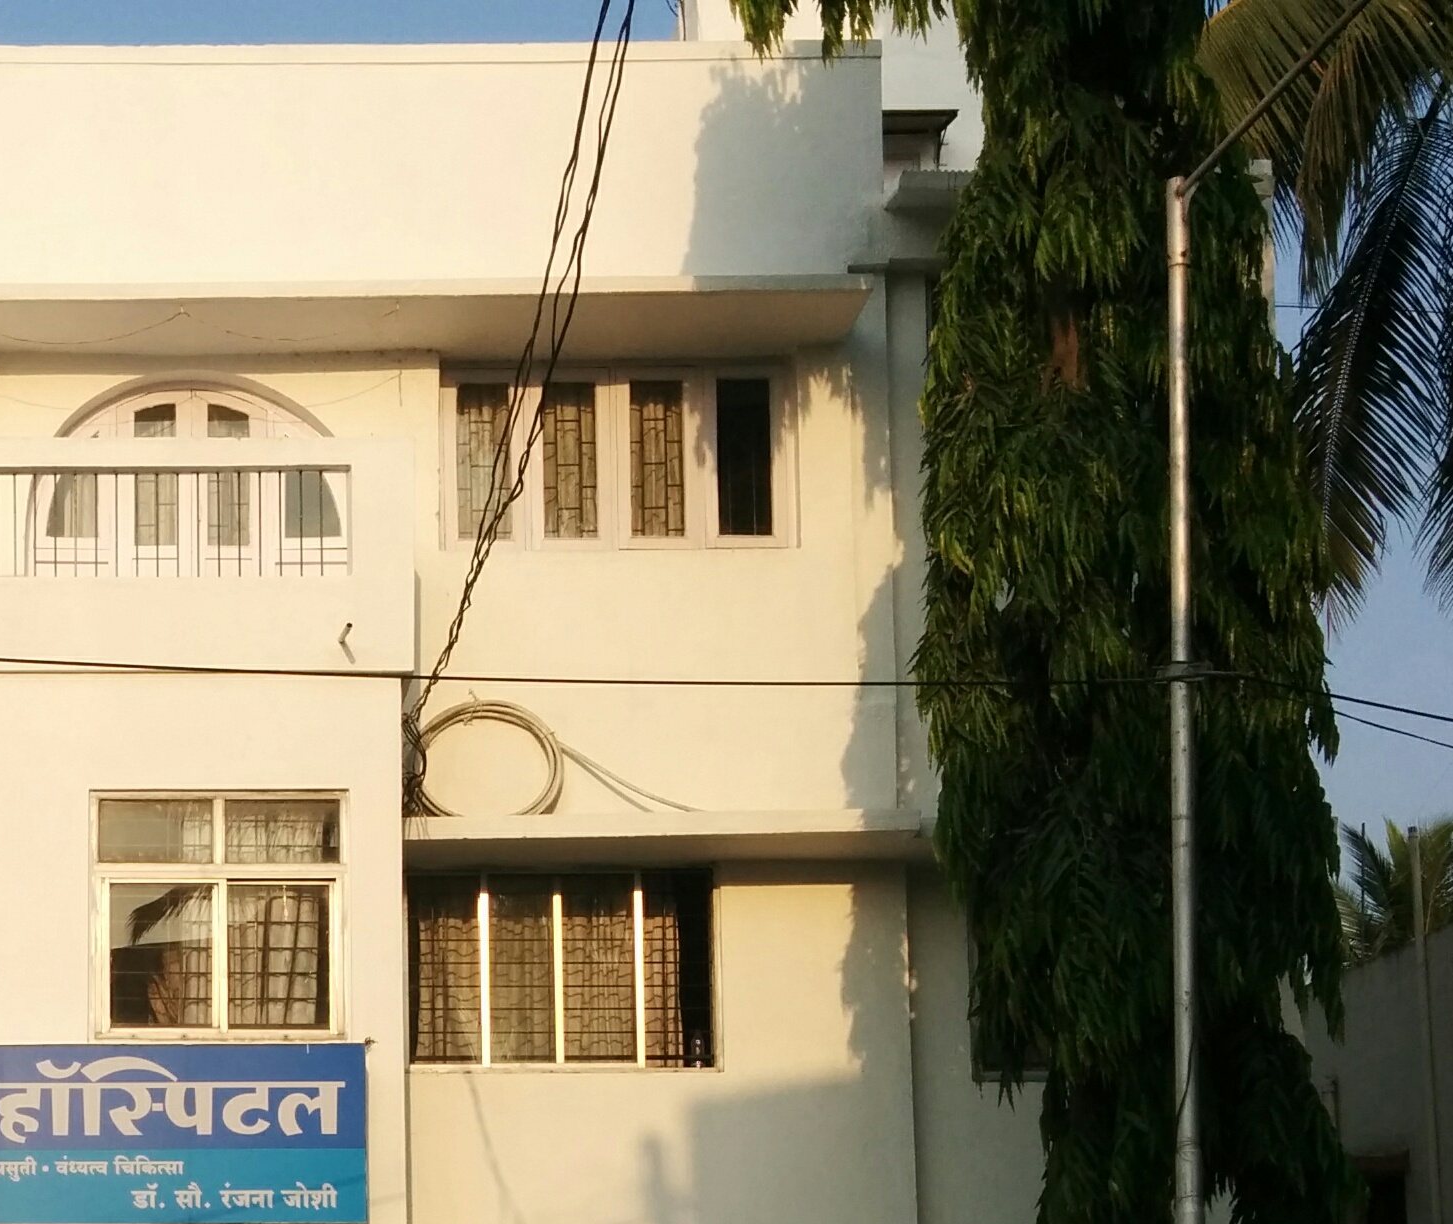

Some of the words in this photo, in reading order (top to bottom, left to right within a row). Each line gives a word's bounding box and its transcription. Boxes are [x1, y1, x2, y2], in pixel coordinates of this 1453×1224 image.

[54, 1154, 108, 1176] वंध्यत्व
[113, 1155, 184, 1176] चिकित्सा
[130, 1182, 166, 1209] डॉ.
[174, 1181, 211, 1210] सौ.
[219, 1182, 274, 1209] रंजना
[280, 1181, 338, 1211] जोशी
